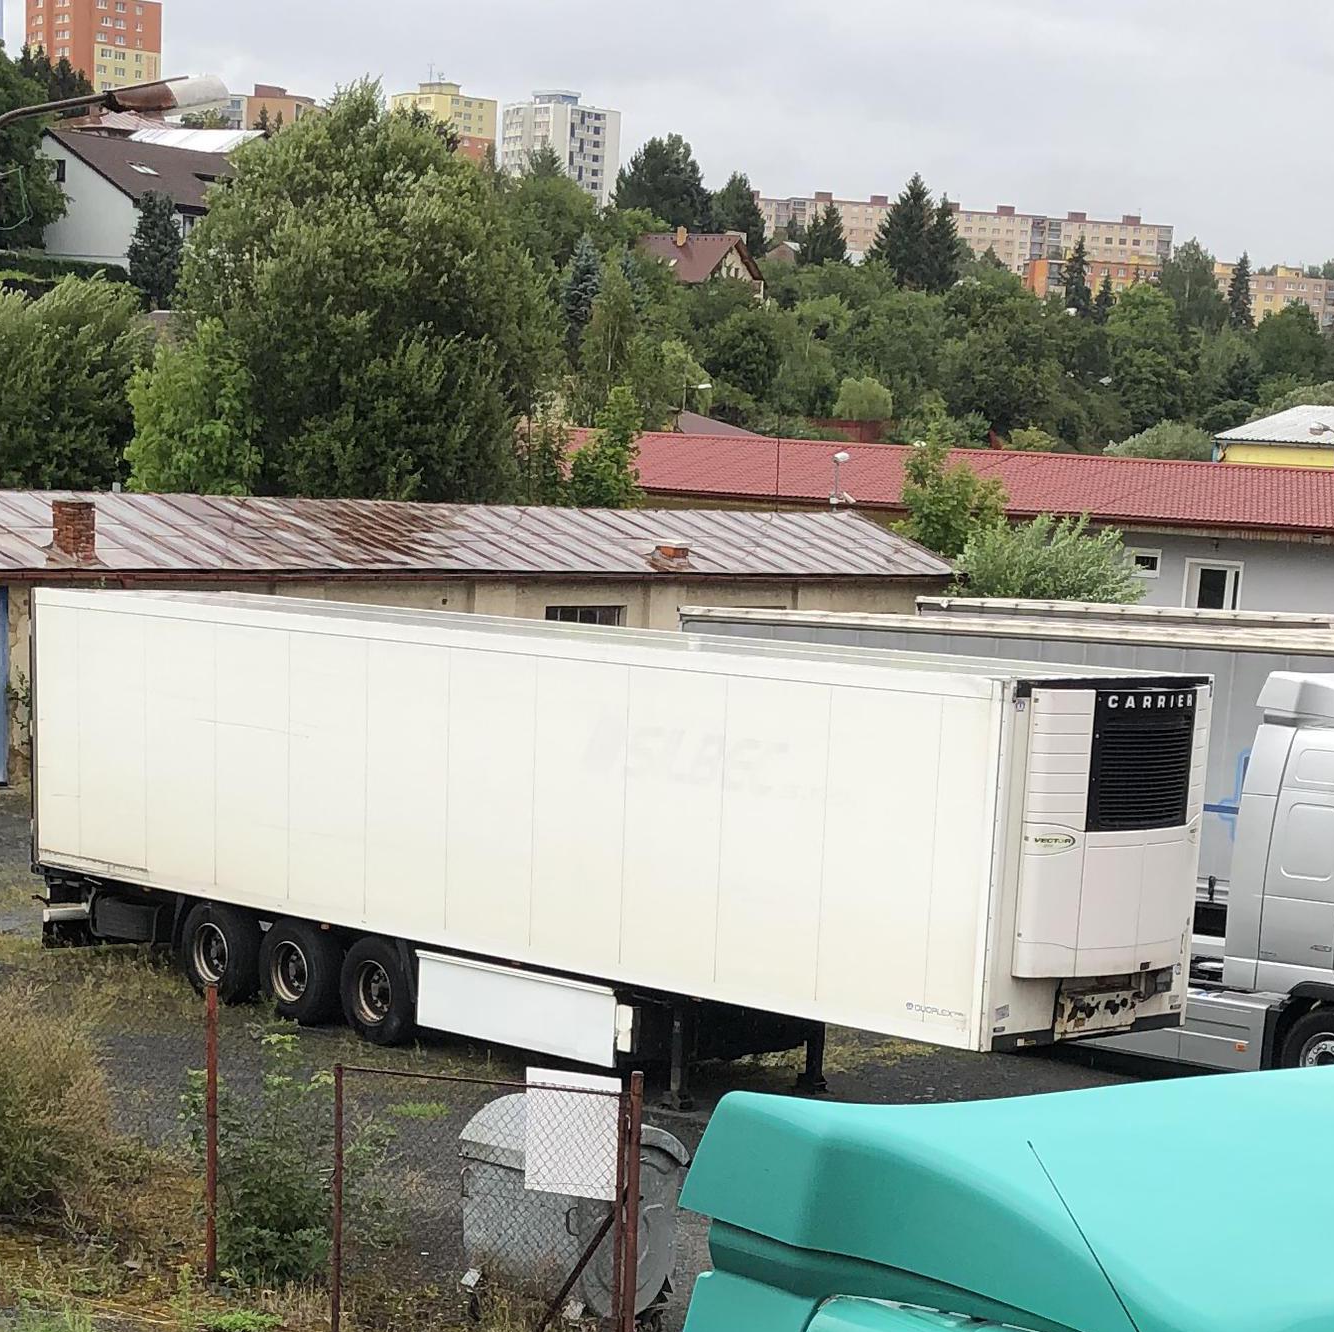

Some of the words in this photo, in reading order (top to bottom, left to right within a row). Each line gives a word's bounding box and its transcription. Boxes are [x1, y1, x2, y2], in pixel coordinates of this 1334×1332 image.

[1107, 694, 1193, 709] CARRIER
[1034, 836, 1072, 844] VECTOR
[914, 1003, 953, 1018] DUOPLEX
